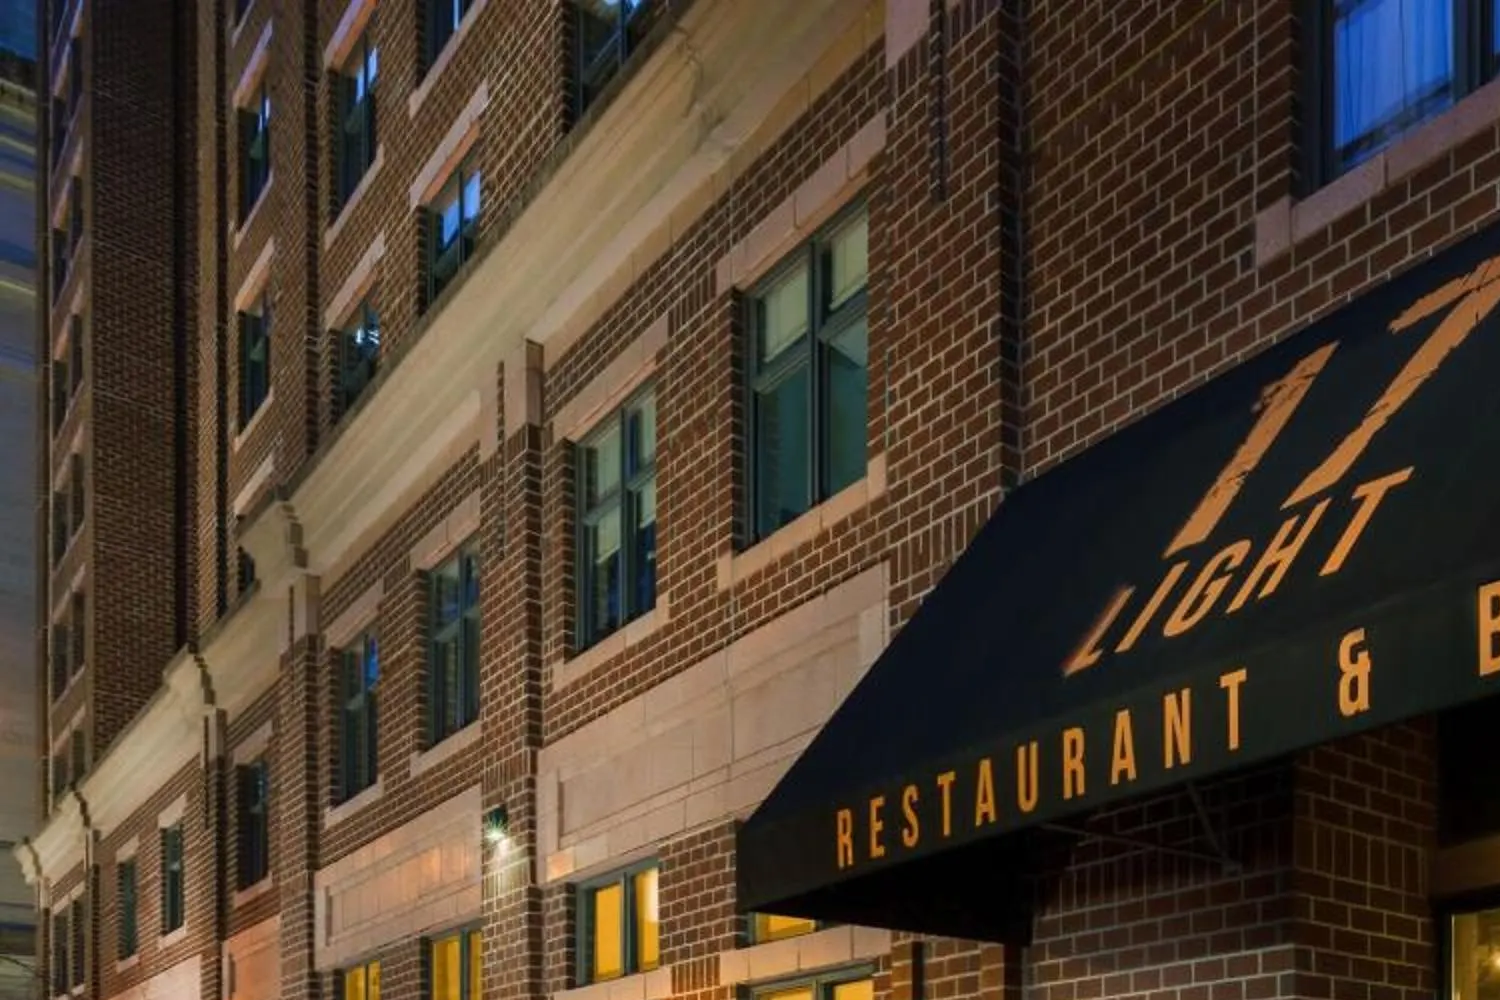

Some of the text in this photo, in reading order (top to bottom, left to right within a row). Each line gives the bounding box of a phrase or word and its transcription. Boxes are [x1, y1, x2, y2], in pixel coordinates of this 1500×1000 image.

[1062, 466, 1413, 677] LIGHT
[836, 667, 1248, 870] RESTAURANT
[1338, 628, 1371, 717] &
